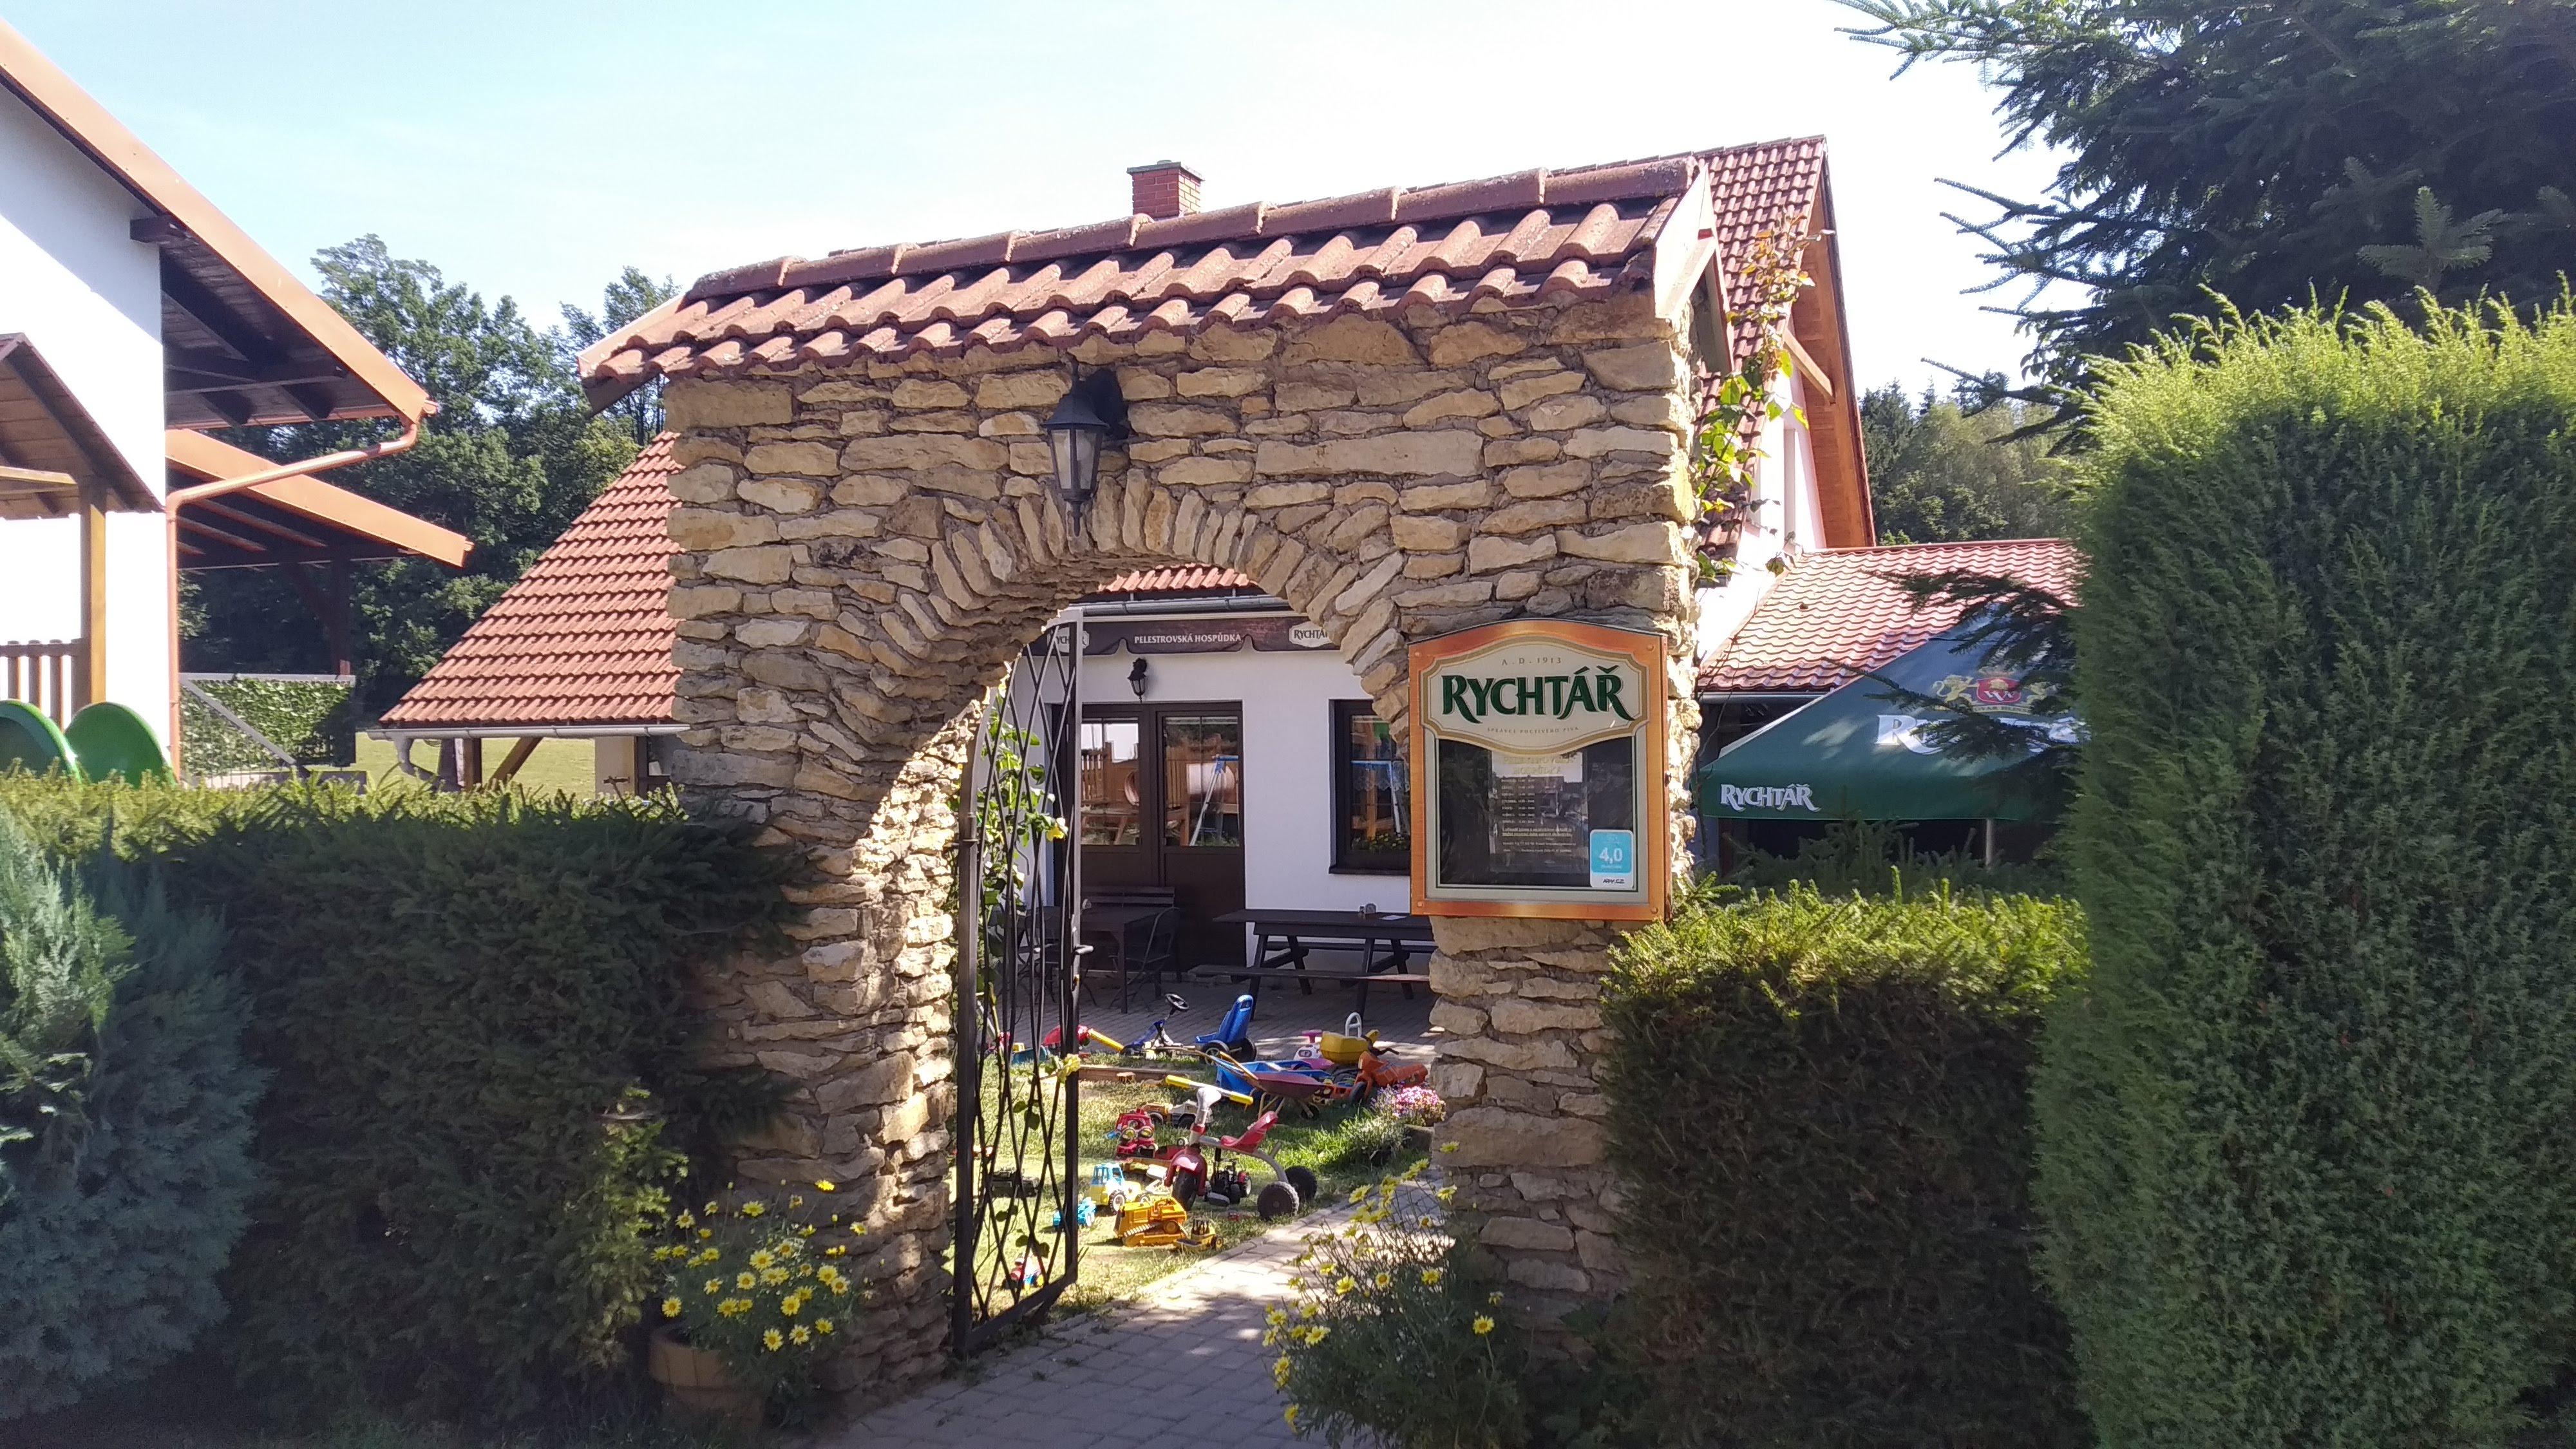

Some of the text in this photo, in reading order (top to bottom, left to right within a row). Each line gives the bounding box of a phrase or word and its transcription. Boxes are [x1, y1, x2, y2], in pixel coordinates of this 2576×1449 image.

[1134, 632, 1242, 643] PELESTROVSKÁ HOSPŮDKA
[1441, 665, 1636, 724] RYCHTÁŘ
[1720, 783, 1822, 812] RYCHTÁŘ
[1599, 847, 1623, 864] 4,0
